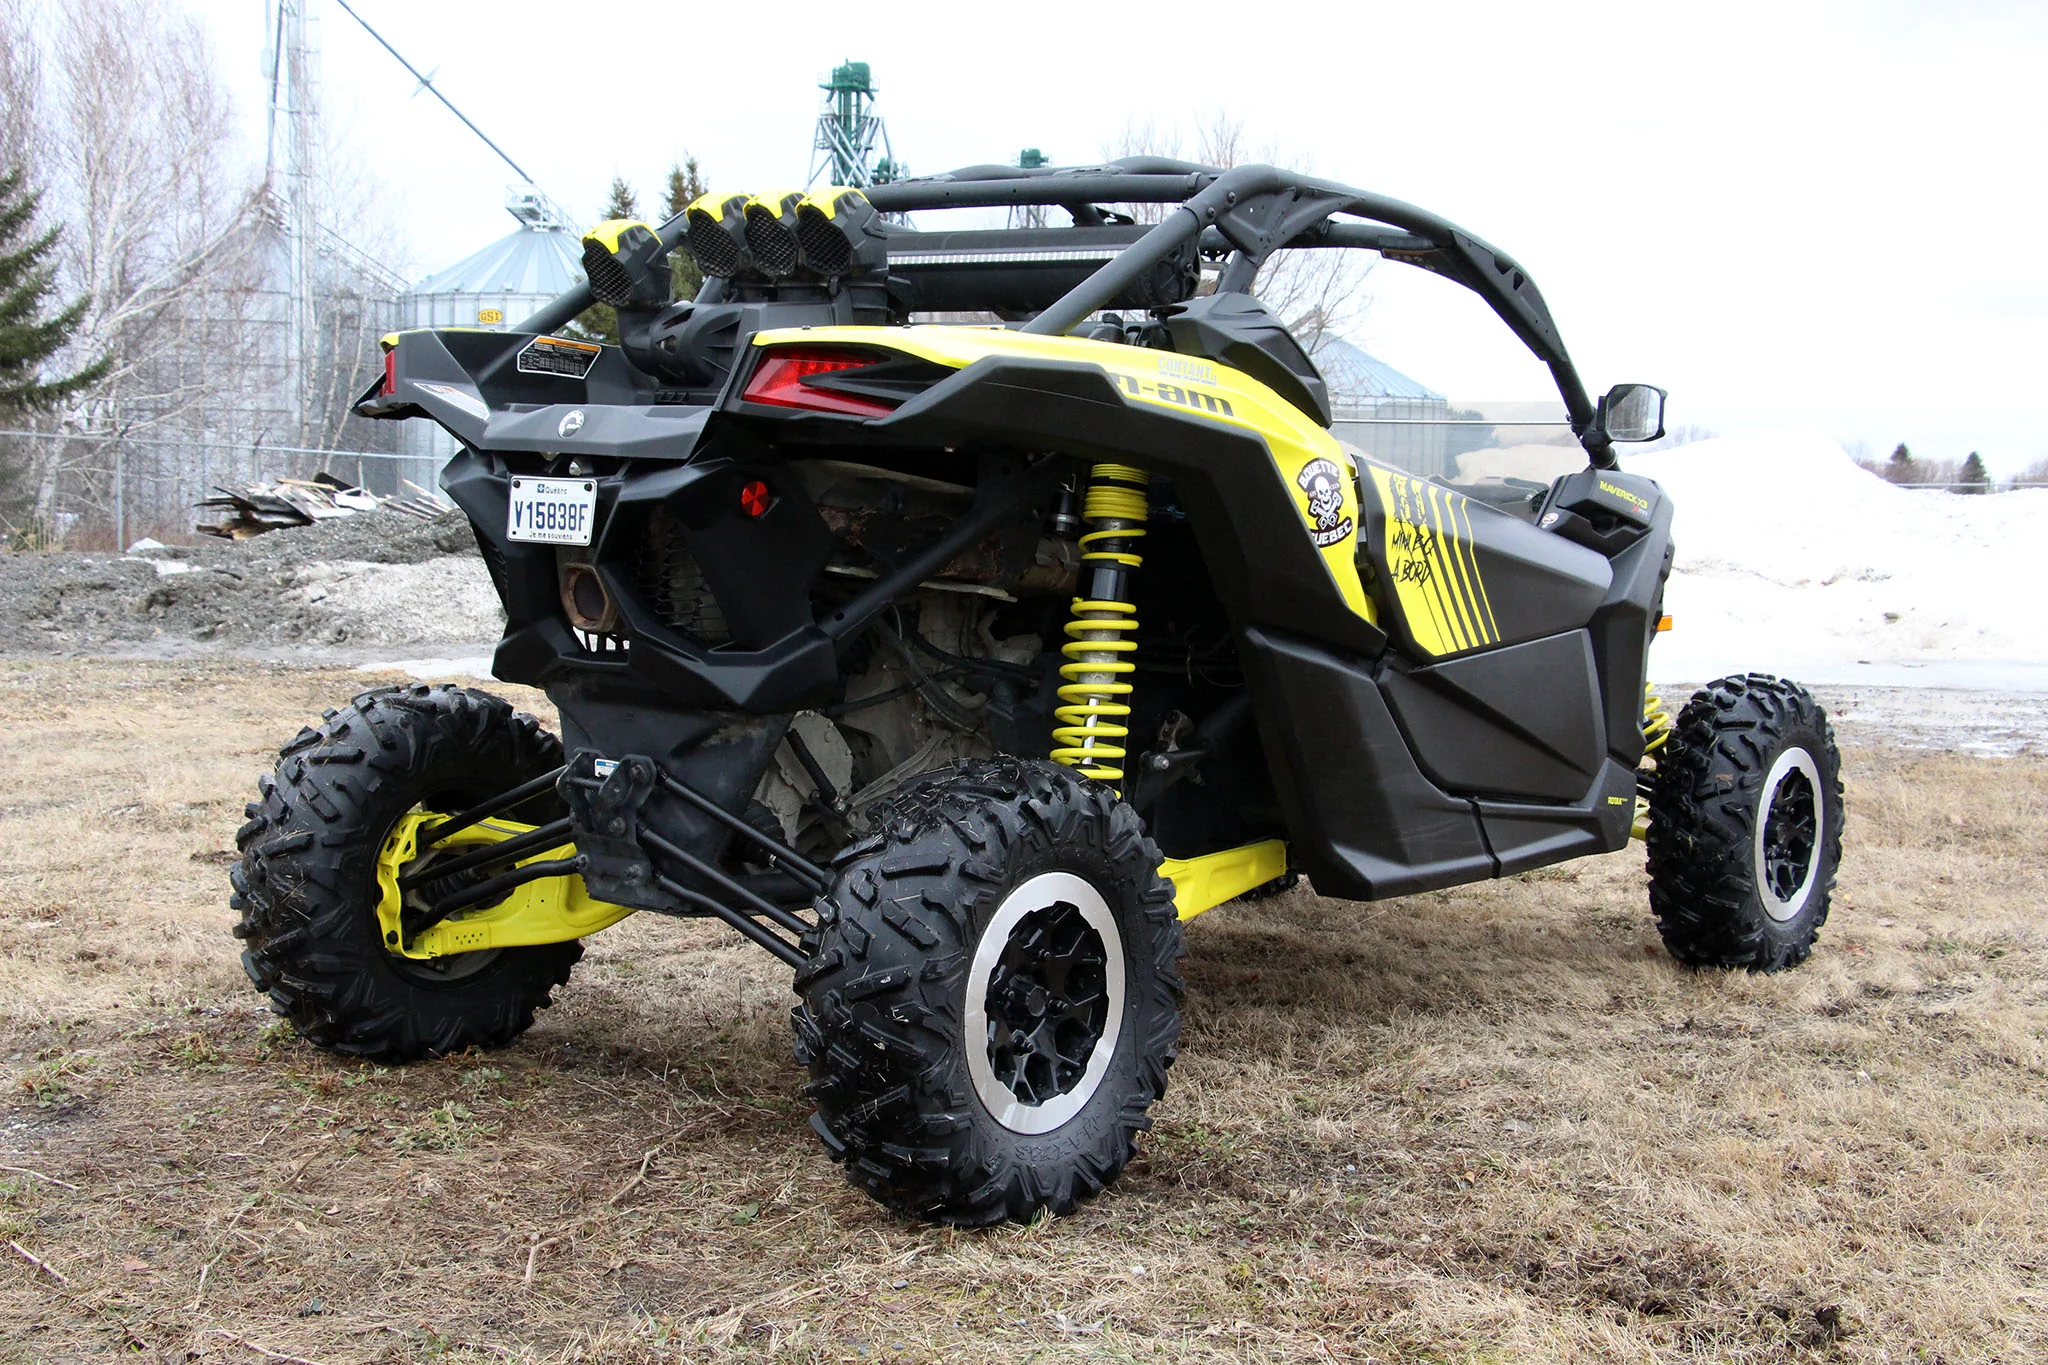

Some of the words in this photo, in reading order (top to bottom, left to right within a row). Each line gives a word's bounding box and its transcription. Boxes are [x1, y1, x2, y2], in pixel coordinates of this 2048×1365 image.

[480, 311, 499, 322] GSI
[1600, 481, 1638, 505] MAVERICK
[514, 500, 589, 532] V15838F
[1313, 519, 1353, 546] UEBEC
